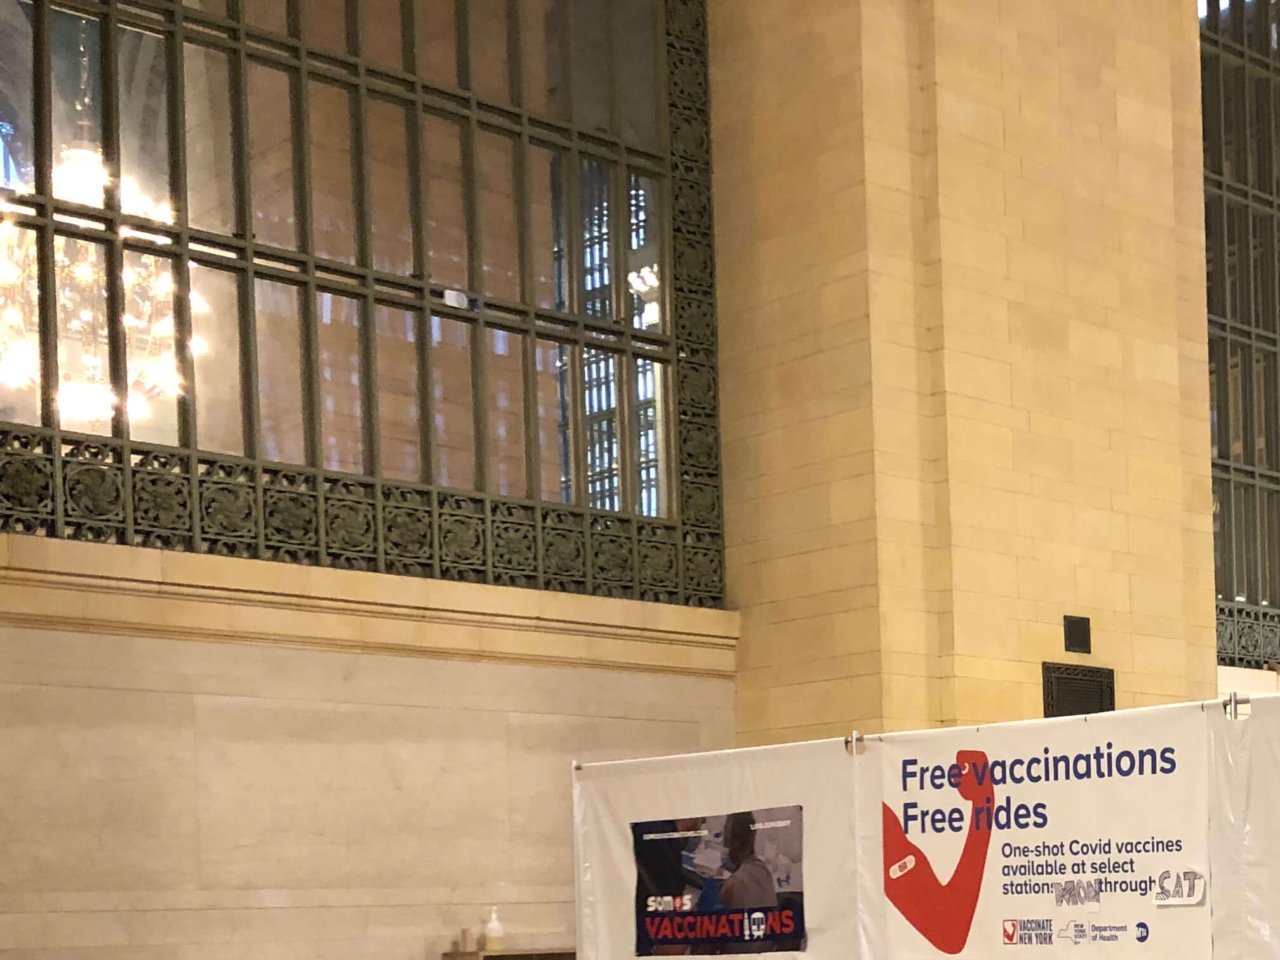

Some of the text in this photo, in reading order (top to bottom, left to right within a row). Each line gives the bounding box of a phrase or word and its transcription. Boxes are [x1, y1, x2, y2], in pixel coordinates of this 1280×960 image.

[902, 742, 1177, 791] Free vaccinations
[903, 796, 1048, 834] Free rides
[1001, 837, 1183, 858] One-shot Covid vaccines
[1002, 858, 1135, 877] available at select
[1099, 876, 1156, 896] through
[1155, 870, 1199, 900] SAT
[1019, 919, 1053, 931] VACCINATE
[1092, 924, 1128, 933] Department
[1020, 933, 1053, 945] NEW YORK
